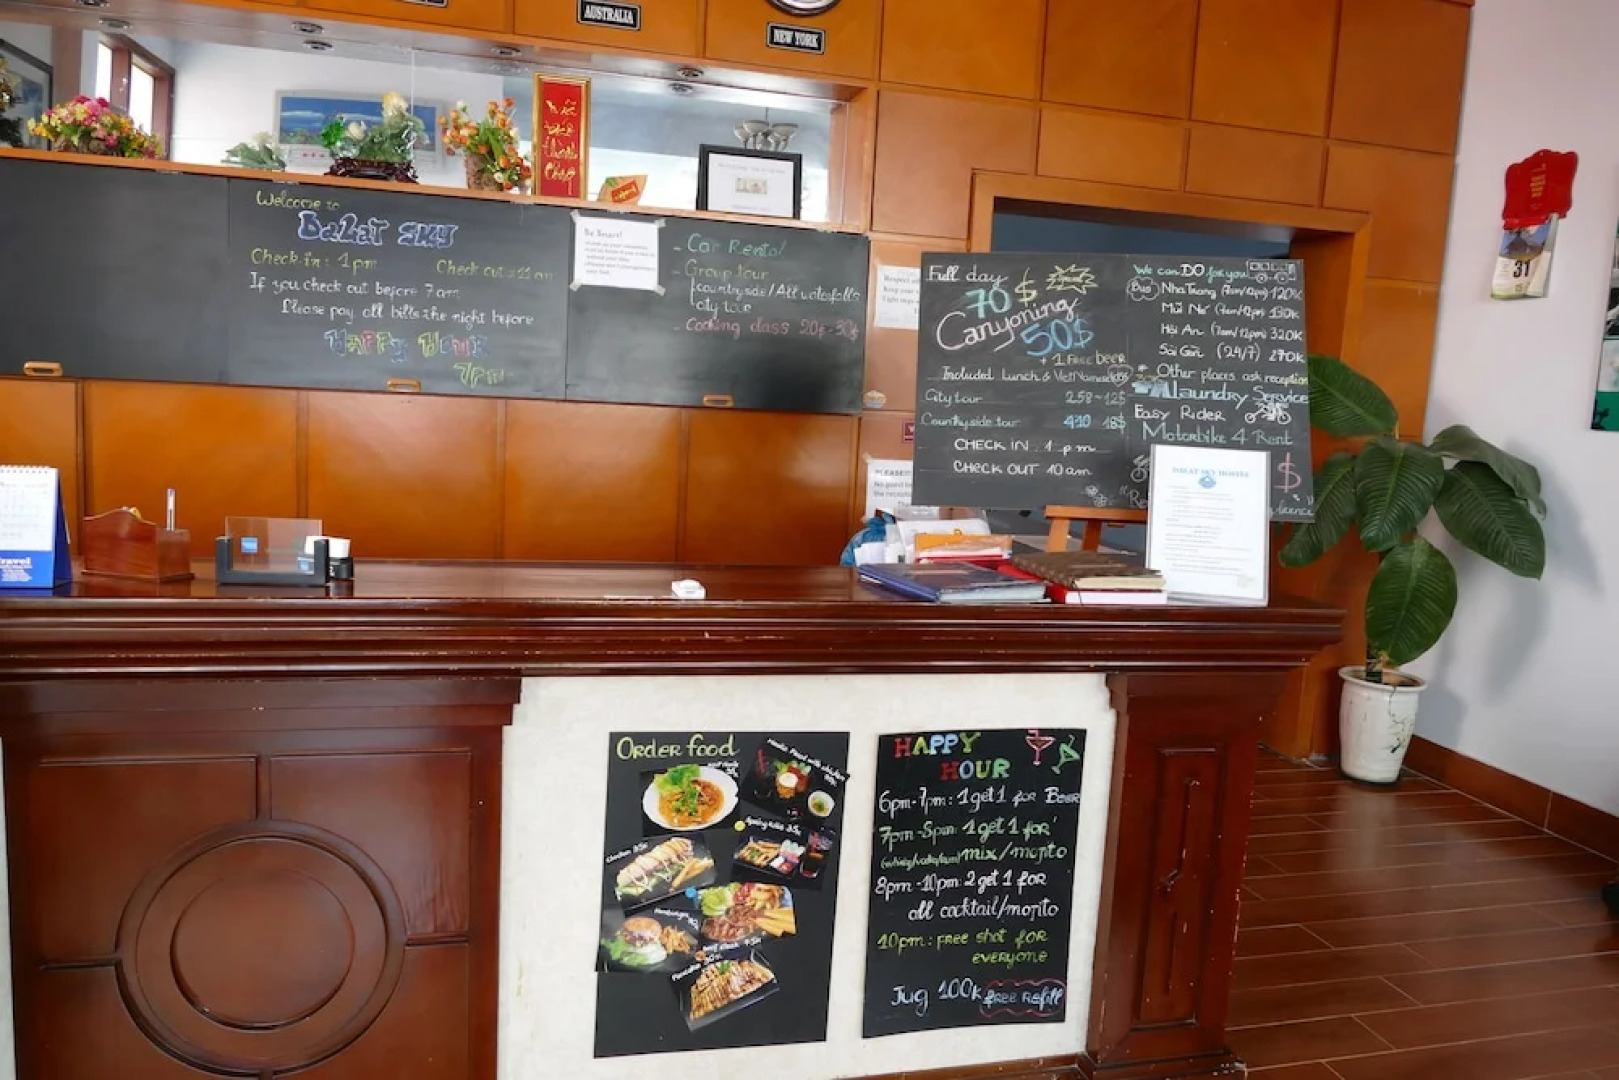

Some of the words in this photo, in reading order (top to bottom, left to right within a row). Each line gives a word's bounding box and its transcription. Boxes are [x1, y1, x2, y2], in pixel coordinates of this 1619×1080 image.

[584, 4, 634, 24] AUSTRALIA
[773, 28, 793, 44] NEW
[794, 31, 819, 48] YORK
[256, 190, 321, 210] Welcome
[687, 233, 719, 254] Car
[728, 239, 788, 257] Rental
[436, 259, 479, 277] Check
[684, 258, 732, 281] Group
[928, 264, 960, 281] Full
[965, 264, 1009, 288] day
[1157, 267, 1181, 276] can
[1180, 263, 1206, 278] DO
[1225, 268, 1248, 284] you
[1513, 259, 1531, 278] 31
[250, 271, 266, 293] If
[272, 280, 300, 295] you
[303, 277, 342, 293] check
[346, 283, 369, 295] out
[375, 281, 418, 300] before
[1131, 280, 1152, 293] Bus
[695, 297, 718, 319] city
[965, 288, 1012, 318] 70
[281, 298, 325, 315] Please
[330, 305, 353, 324] pay
[363, 302, 384, 318] all
[391, 304, 420, 320] bills
[422, 305, 447, 321] the
[451, 308, 486, 330] night
[491, 309, 534, 330] before
[685, 316, 741, 339] Cooking
[750, 316, 790, 335] class
[936, 298, 1078, 352] Canyoning
[1019, 315, 1094, 356] 50$
[1181, 323, 1205, 336] An
[1216, 341, 1261, 361] (24/7)
[941, 365, 994, 382] Included
[1001, 366, 1041, 381] Lunch
[1157, 362, 1197, 379] Other
[1200, 367, 1236, 384] places
[1242, 371, 1262, 383] ask
[924, 388, 953, 407] City
[954, 392, 983, 404] tour
[1252, 385, 1309, 404] Service
[997, 416, 1021, 428] tour
[1134, 403, 1170, 420] Easy
[1180, 405, 1227, 422] Rider
[1142, 421, 1227, 445] Motorbike
[1231, 427, 1249, 446] 4
[1253, 429, 1294, 446] Rent
[954, 438, 1006, 451] CHECK
[1007, 463, 1040, 475] OUT
[616, 736, 682, 760] Order
[686, 734, 741, 758] food
[894, 731, 981, 758] HAPPY
[940, 757, 1011, 780] HOUR
[964, 870, 976, 886] 2
[977, 869, 999, 894] get
[1017, 870, 1048, 895] for
[908, 900, 934, 921] all
[975, 928, 1008, 944] shot
[972, 951, 1048, 969] everyone
[891, 985, 930, 1017] Jug
